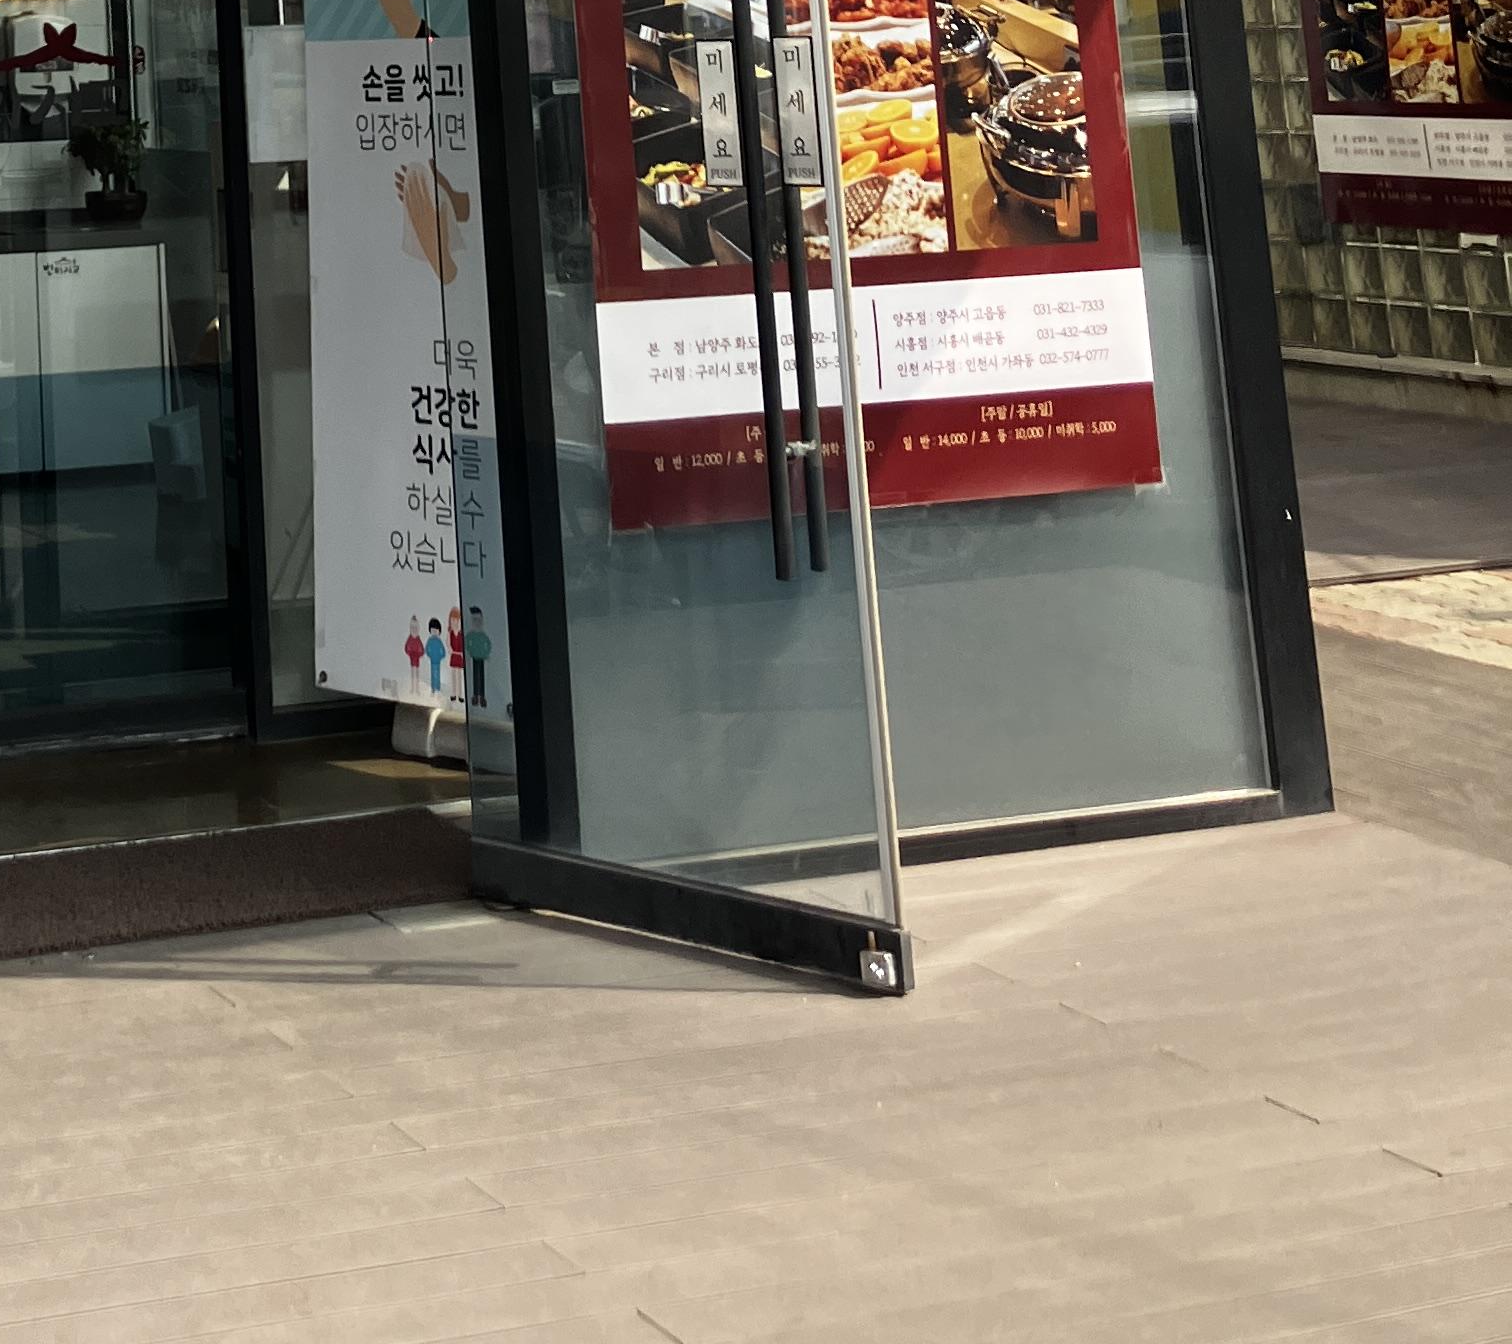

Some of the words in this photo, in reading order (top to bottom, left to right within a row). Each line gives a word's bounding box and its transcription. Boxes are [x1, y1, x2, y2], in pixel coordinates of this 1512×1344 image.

[361, 64, 405, 104] 손을
[705, 48, 733, 158] 미세요
[783, 45, 811, 157] 미세요
[355, 113, 467, 153] 입장하시면
[710, 168, 737, 180] PUSH
[788, 167, 816, 180] PUSH
[893, 310, 926, 328] 양주점
[936, 307, 970, 326] 양주시
[1033, 299, 1105, 316] 031-821-7333
[1037, 324, 1108, 341] 031-432-4329
[696, 363, 731, 381] 구리시
[734, 360, 759, 377] 토평
[1039, 348, 1110, 365] 032-574-0777
[410, 385, 480, 430] 건강한
[412, 434, 483, 480] 식사를
[406, 482, 453, 526] 하실
[460, 490, 486, 531] 수
